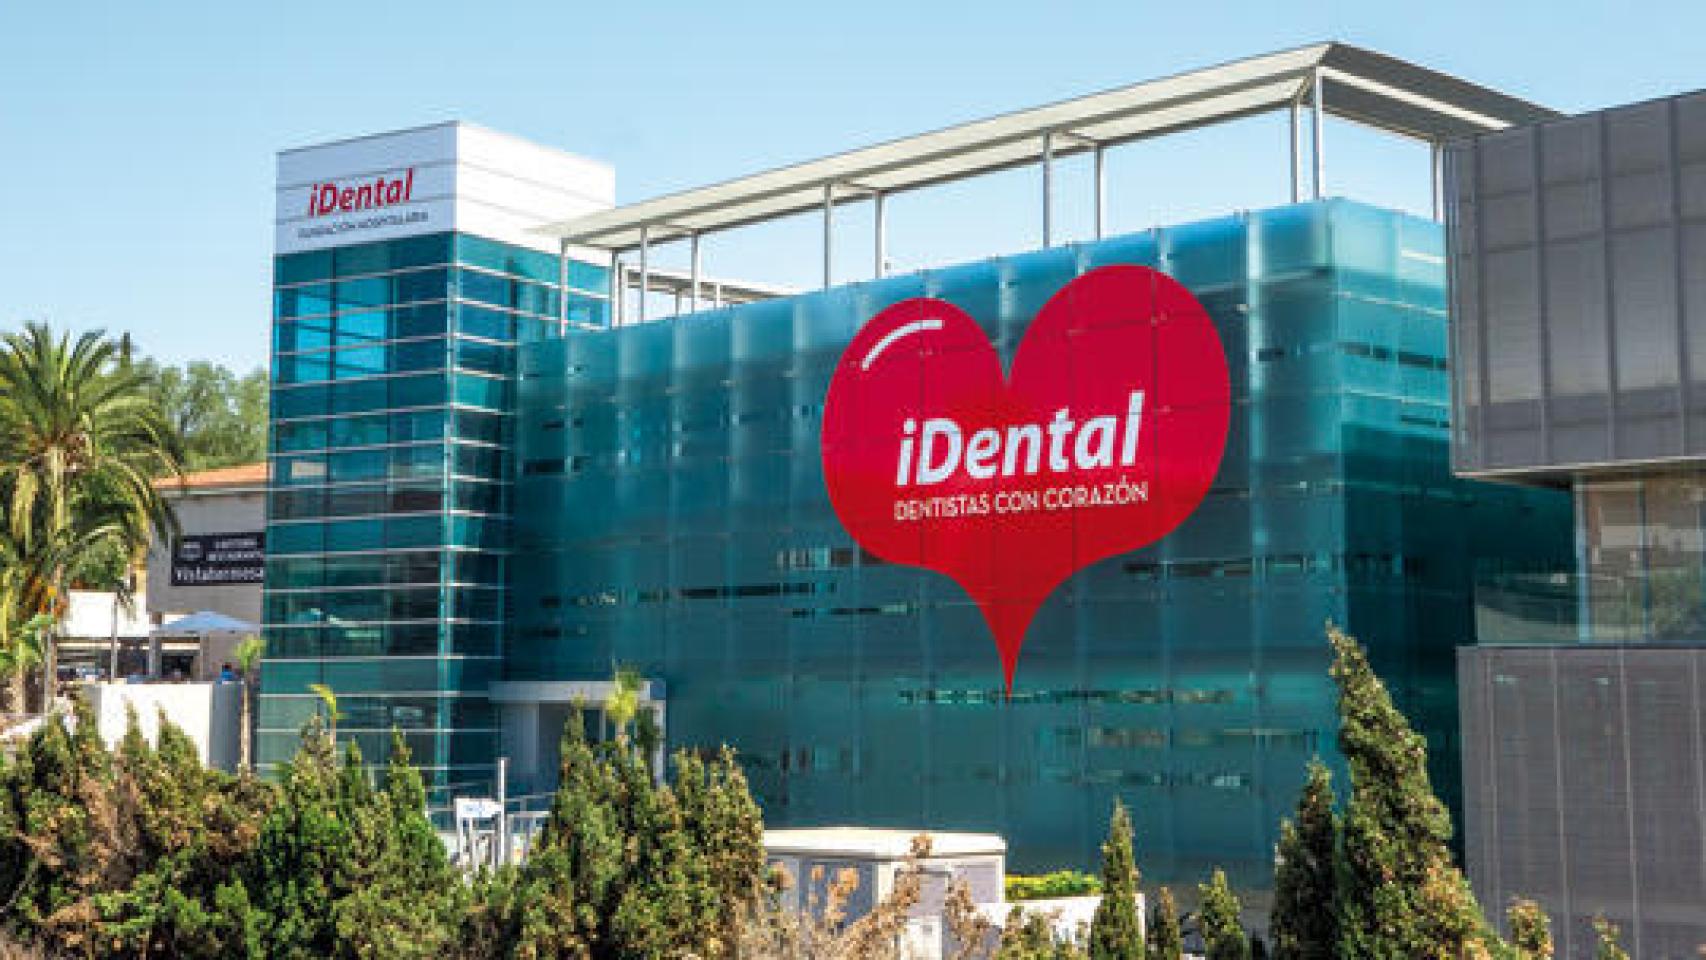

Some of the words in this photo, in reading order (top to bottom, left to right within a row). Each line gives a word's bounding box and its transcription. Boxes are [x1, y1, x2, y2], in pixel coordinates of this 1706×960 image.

[309, 167, 414, 217] iDental
[896, 390, 1145, 486] iDental
[894, 495, 990, 521] DENTISTAS
[995, 491, 1038, 513] CON
[1043, 476, 1149, 509] CORAZÓN
